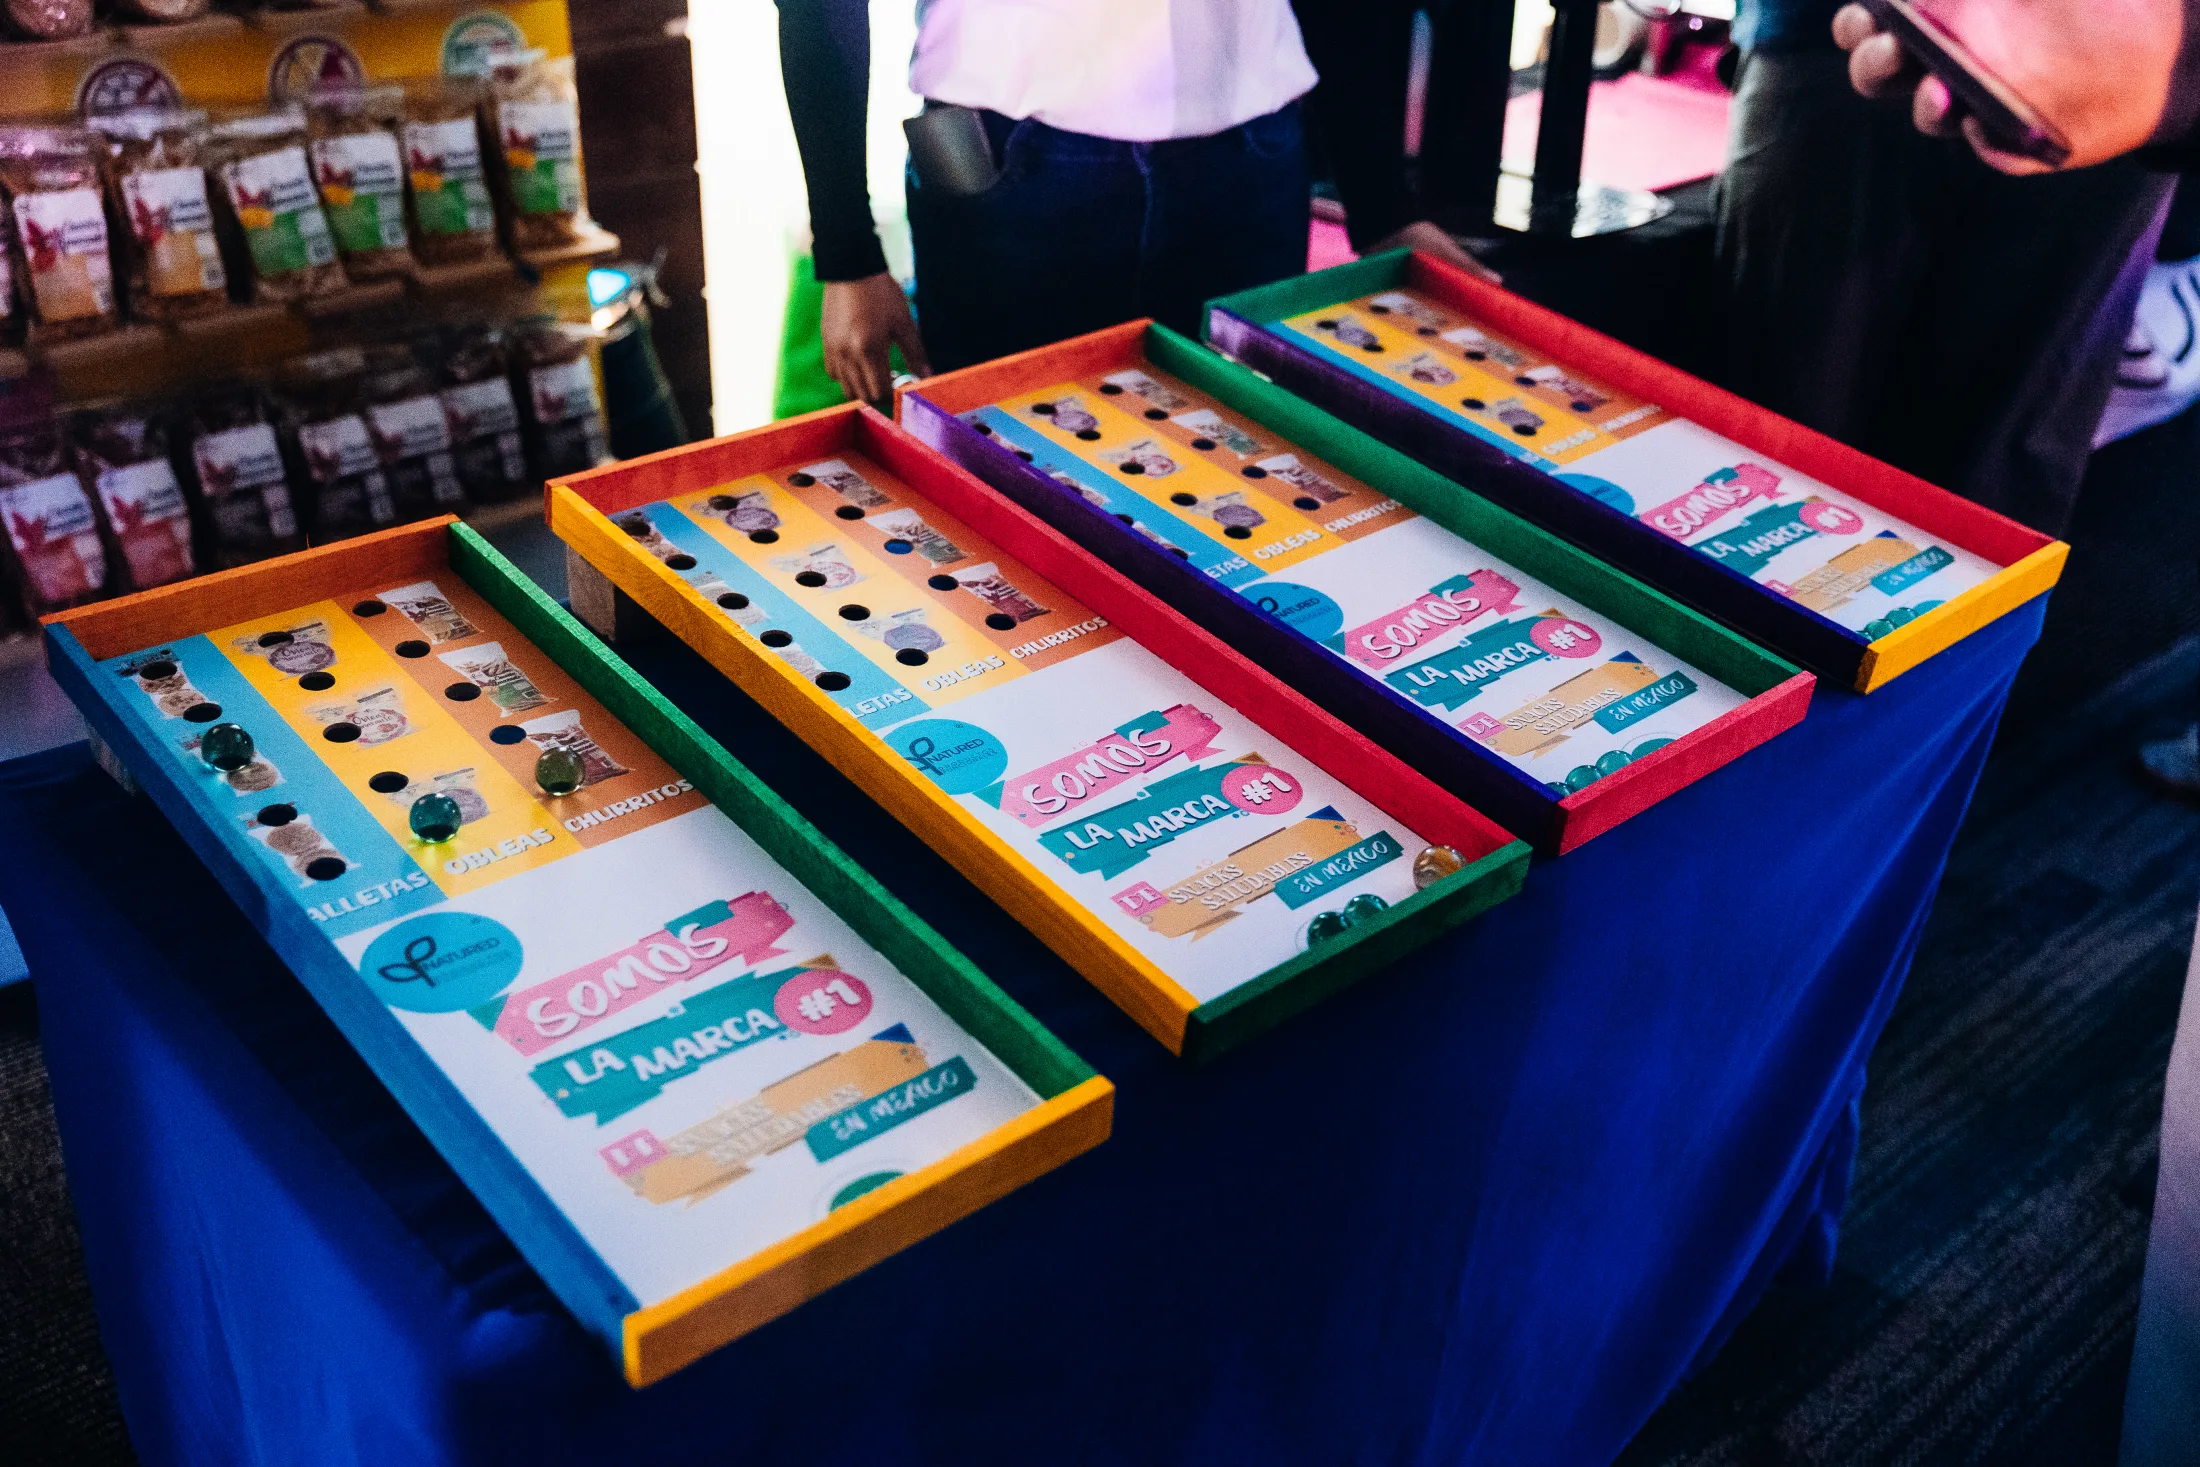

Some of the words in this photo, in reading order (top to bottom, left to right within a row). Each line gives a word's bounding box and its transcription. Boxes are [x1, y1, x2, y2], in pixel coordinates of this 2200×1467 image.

[1654, 479, 1750, 537] SOMOS
[1254, 528, 1322, 560] OBLEAS
[1700, 540, 1737, 558] LA
[1738, 521, 1814, 557] MARCA
[1010, 616, 1110, 659] CHURRITOS
[1362, 588, 1482, 660] SOMOS
[921, 655, 1006, 692] OBLEAS
[1408, 665, 1448, 688] LA
[1450, 641, 1543, 686] MARCA
[1546, 623, 1593, 650] #1
[1506, 698, 1566, 731] SNACKS
[1534, 687, 1623, 736] SALUDABLES
[1615, 708, 1635, 722] EN
[1634, 678, 1685, 710] MEXICO
[1464, 716, 1500, 735] DE
[926, 738, 985, 765] NATURED
[1022, 728, 1172, 816] SOMOS
[564, 779, 695, 833] CHURRITOS
[1064, 823, 1114, 850] LA
[1117, 794, 1231, 849] MARCA
[1241, 772, 1293, 805] #1
[443, 827, 556, 876] OBLEAS
[1293, 876, 1323, 894] EN
[1323, 840, 1388, 881] MEXICO
[1119, 889, 1161, 910] DE
[1168, 864, 1245, 905] SNACKS
[1200, 851, 1314, 911] SALUDABLES
[420, 937, 500, 971] NATURED
[526, 922, 729, 1038] SOMOS
[564, 1047, 626, 1084] LA
[630, 1008, 780, 1081] MARCA
[797, 978, 863, 1023] #1
[831, 1113, 868, 1142] EN
